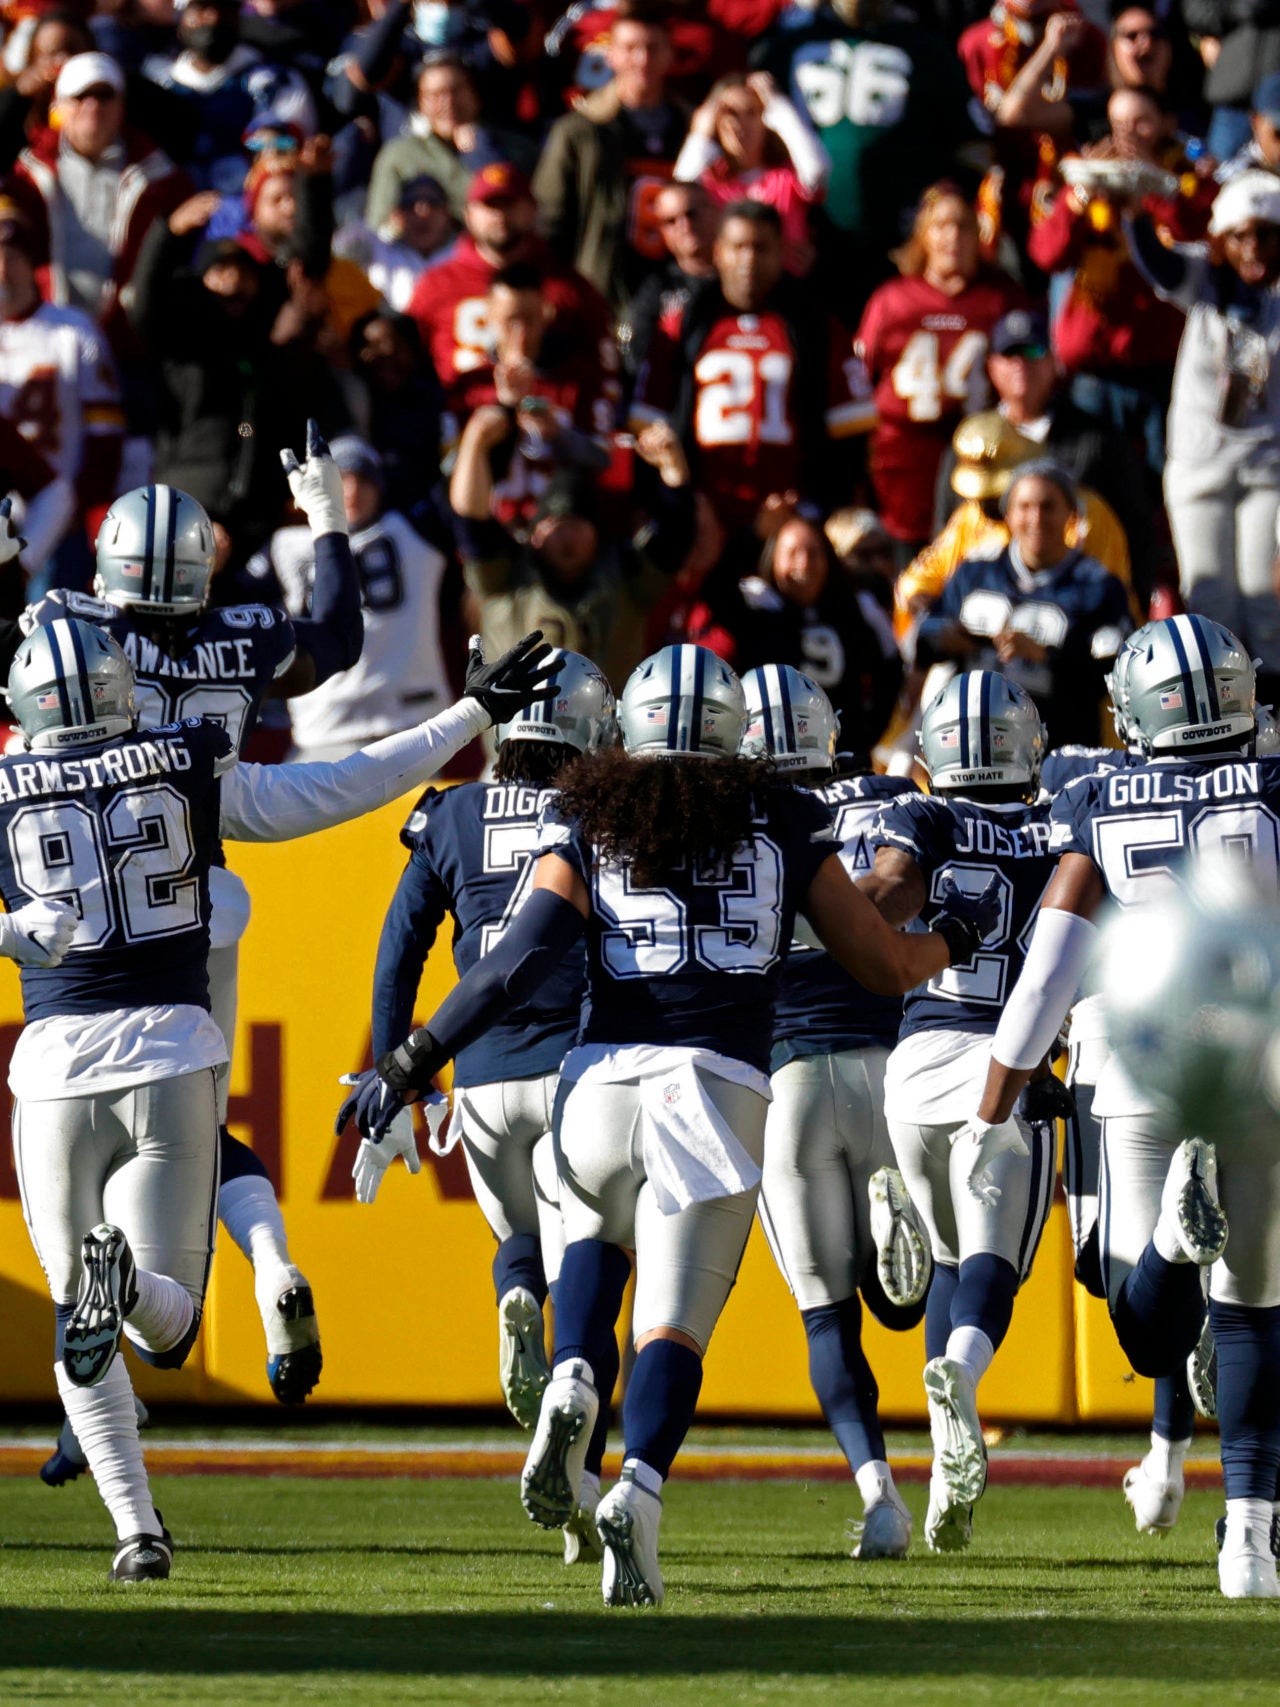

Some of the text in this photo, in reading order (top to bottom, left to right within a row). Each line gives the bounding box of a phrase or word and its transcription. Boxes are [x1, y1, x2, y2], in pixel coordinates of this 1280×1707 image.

[695, 350, 793, 446] 21
[57, 726, 108, 743] COWBOYS
[517, 723, 557, 736] COWBOYS
[1182, 724, 1232, 741] COWBOYS
[950, 771, 1003, 783] STOP HATE
[1109, 763, 1259, 806] GOLSTON
[7, 785, 202, 951] 92
[592, 832, 785, 980] 53
